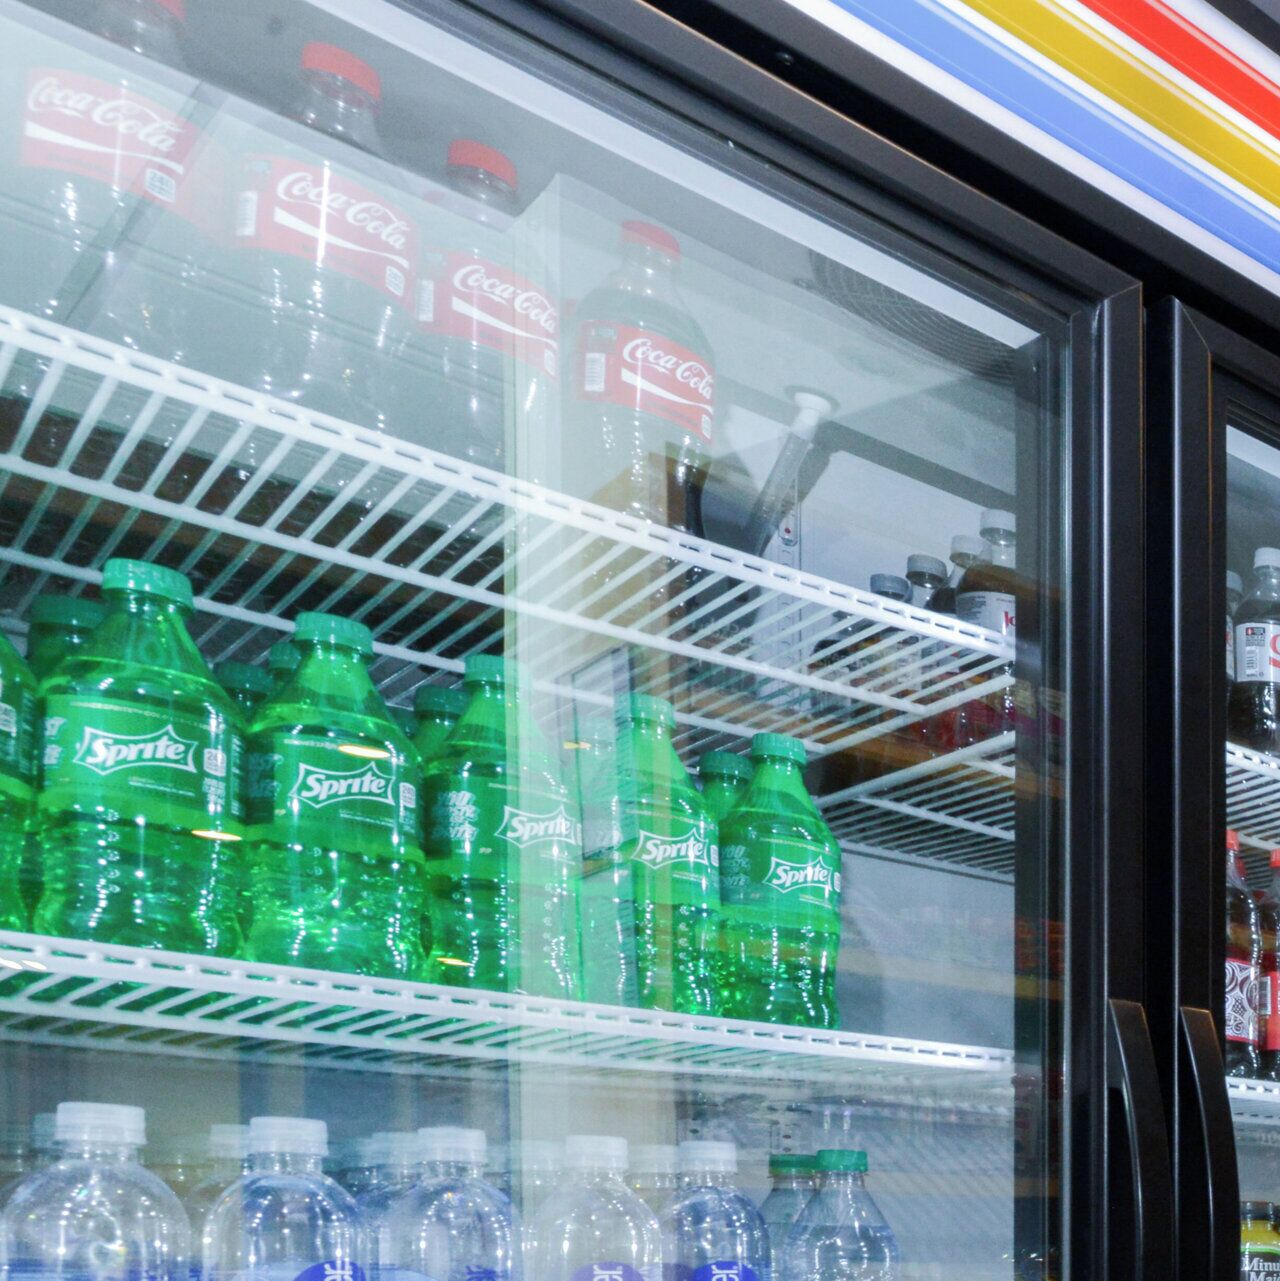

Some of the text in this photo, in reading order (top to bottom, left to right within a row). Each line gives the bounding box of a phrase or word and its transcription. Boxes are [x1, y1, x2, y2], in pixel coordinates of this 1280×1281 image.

[27, 76, 184, 153] Coca-Cola
[277, 172, 411, 250] Coca-Cola
[453, 265, 556, 334] Coca-Cola
[623, 338, 713, 399] Coca-Cola
[86, 730, 186, 763] Sprite
[301, 768, 386, 798] Sprite
[507, 812, 573, 841] Sprite
[641, 833, 706, 861] Sprite
[773, 865, 829, 888] Sprite
